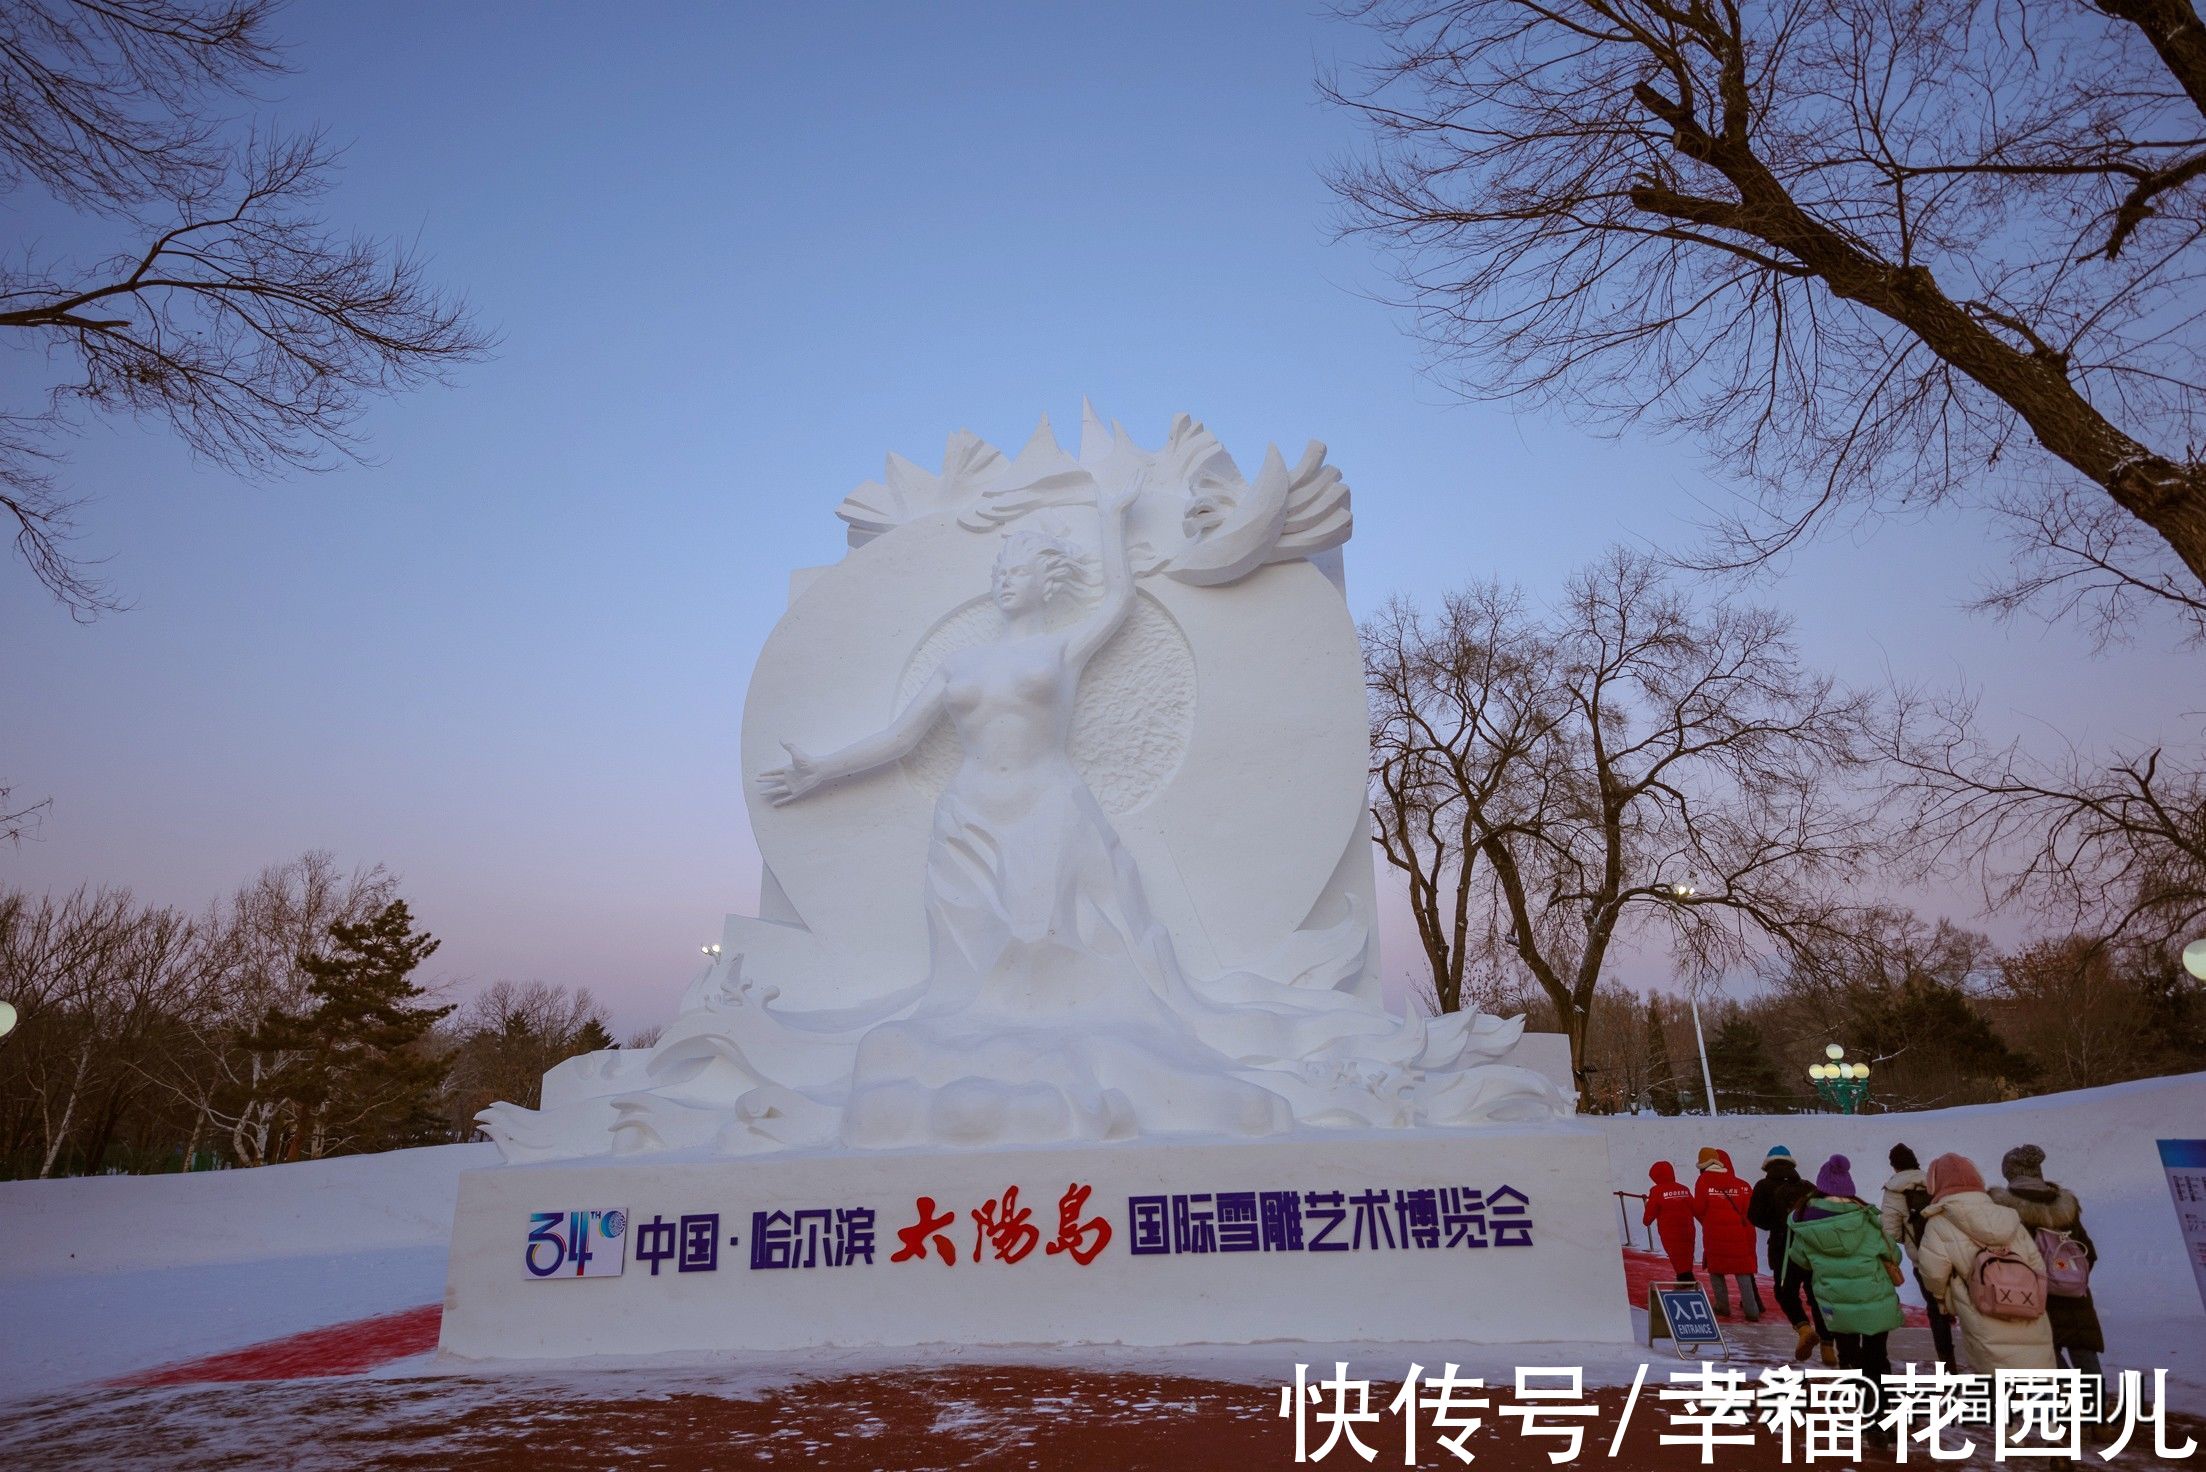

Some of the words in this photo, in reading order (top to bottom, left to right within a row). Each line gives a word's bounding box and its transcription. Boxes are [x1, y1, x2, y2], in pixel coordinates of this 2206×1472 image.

[1128, 1184, 1534, 1256] 国际雪雕艺术博览会
[1672, 1299, 1708, 1320] 入口
[1677, 1324, 1712, 1334] ENTRANCE
